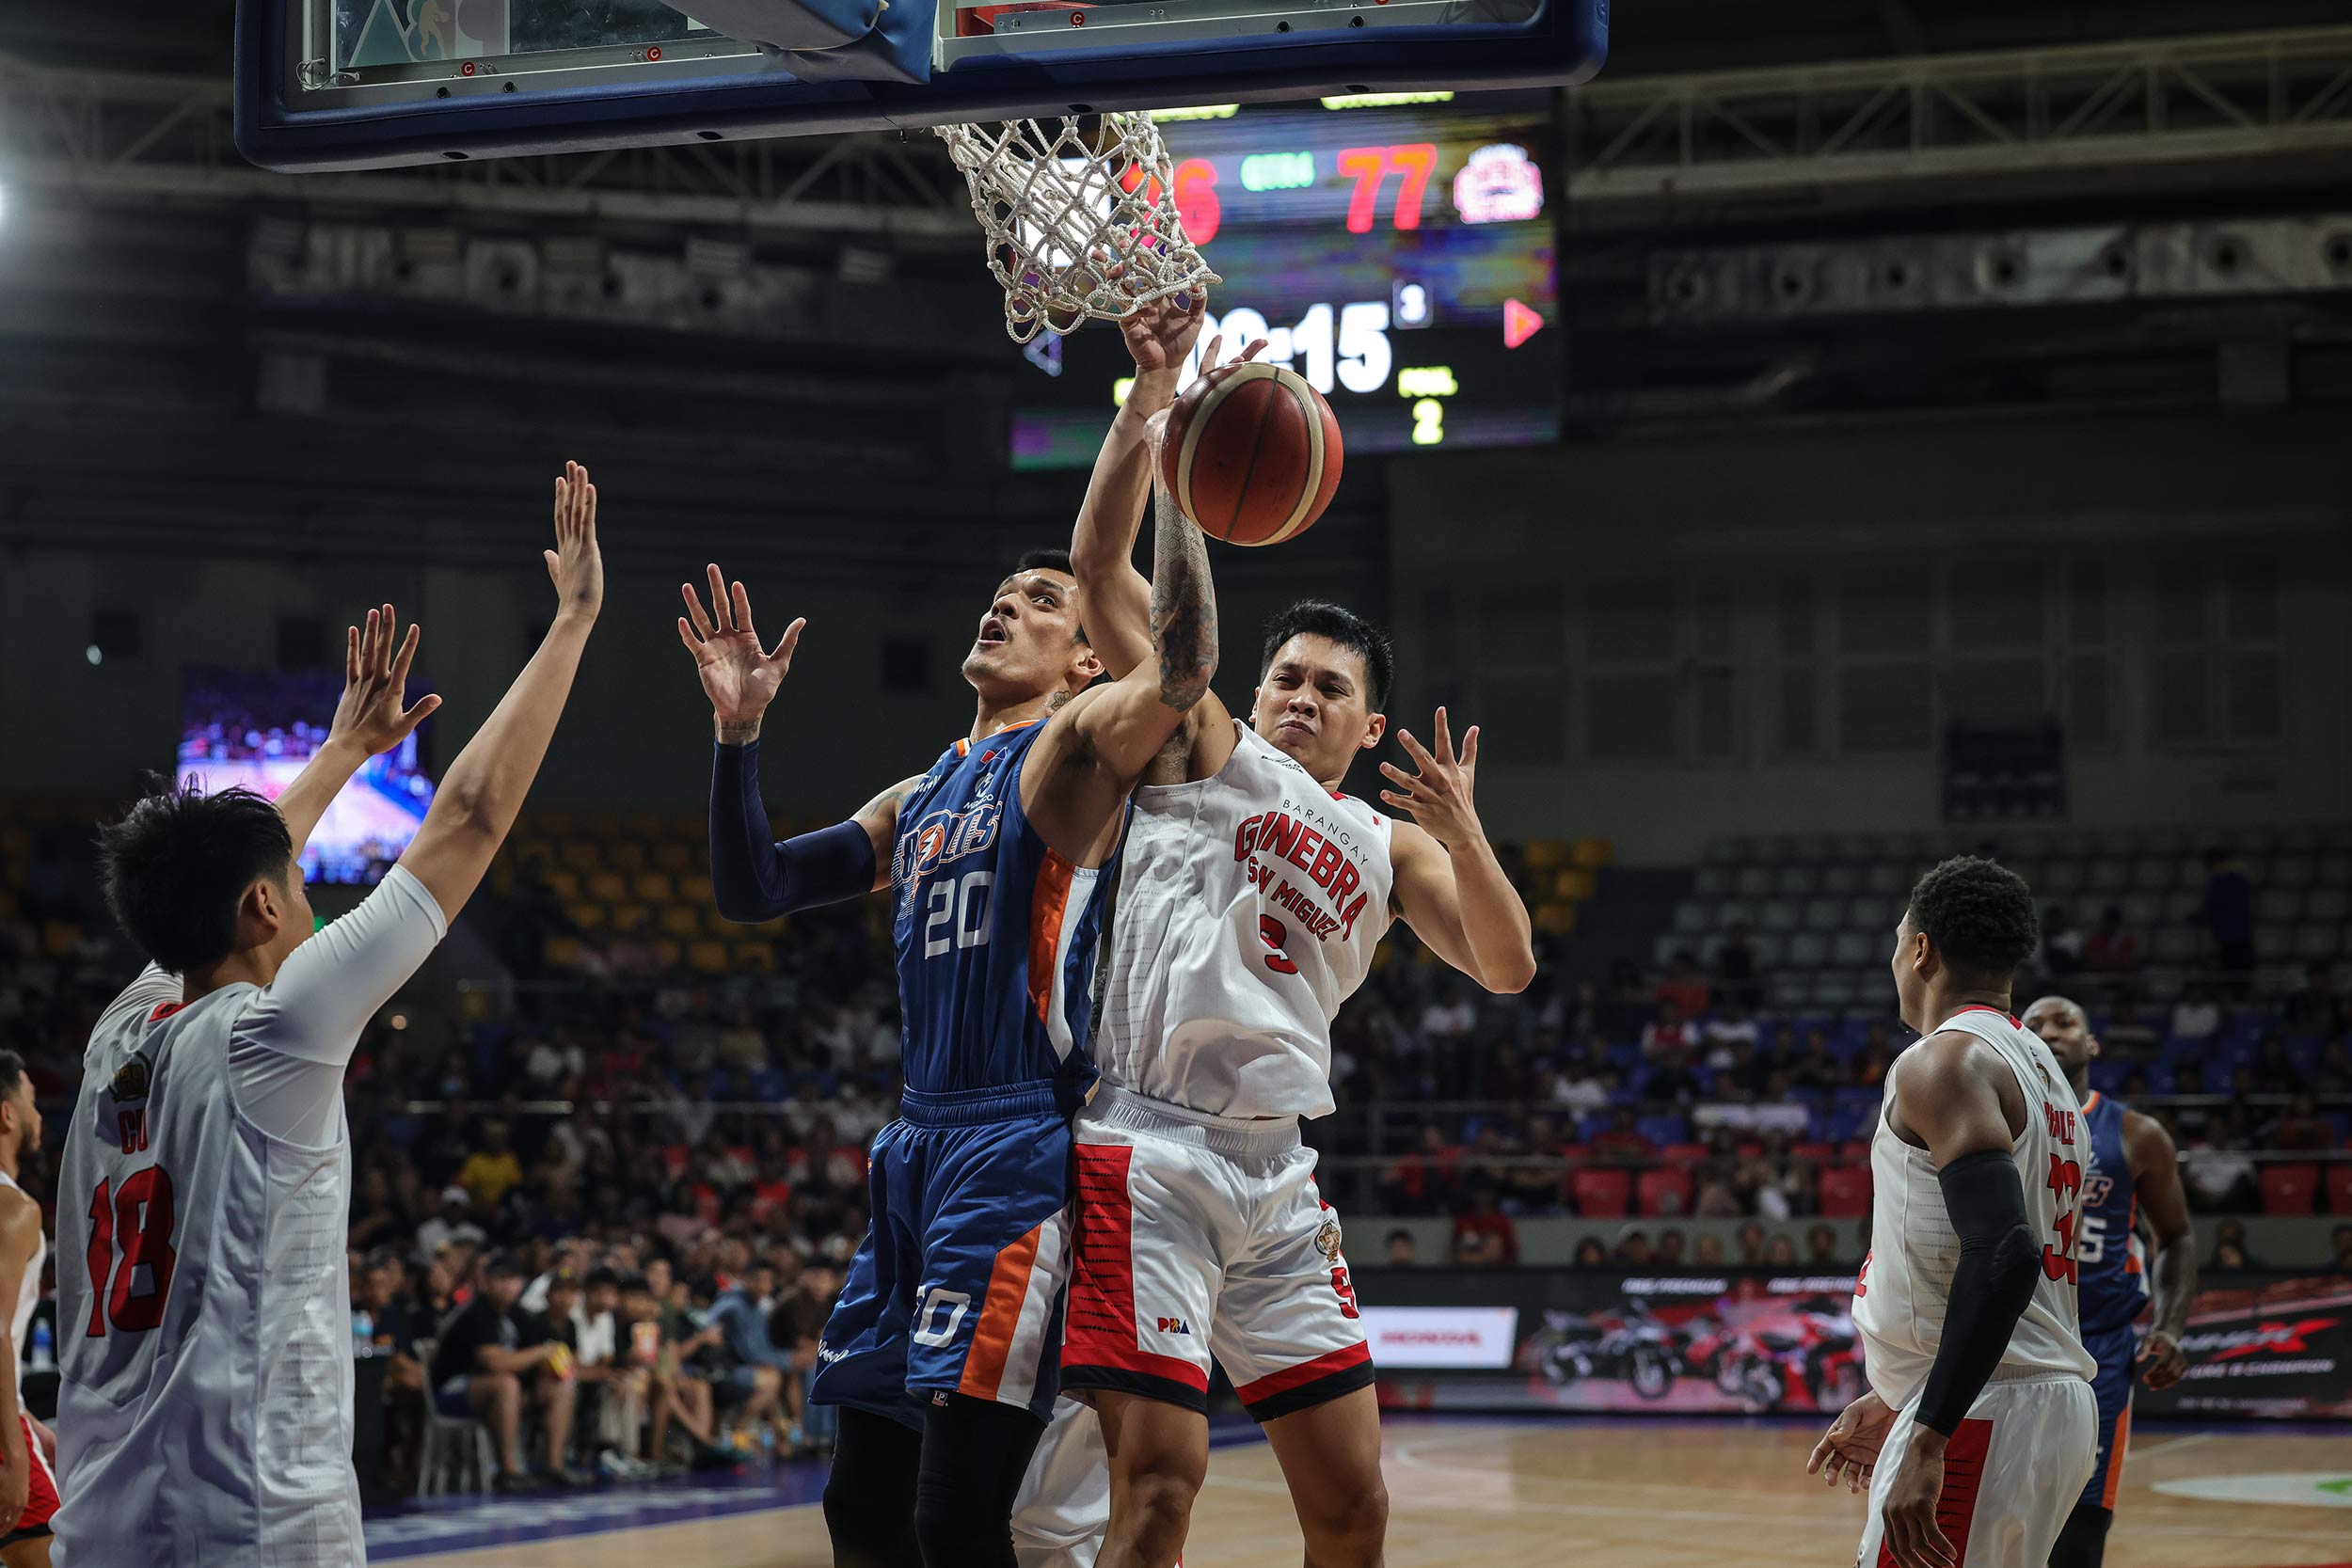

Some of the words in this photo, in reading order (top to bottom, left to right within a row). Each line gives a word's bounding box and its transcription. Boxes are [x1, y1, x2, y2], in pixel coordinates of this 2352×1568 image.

[1337, 143, 1437, 233] 77
[1412, 397, 1444, 445] 2
[1282, 799, 1369, 865] BARANGAY
[925, 870, 995, 959] 20
[1233, 811, 1368, 942] GINEBRA
[1270, 879, 1341, 942] MIGUEL
[87, 1164, 176, 1338] 18
[1157, 1317, 1190, 1335] PBA
